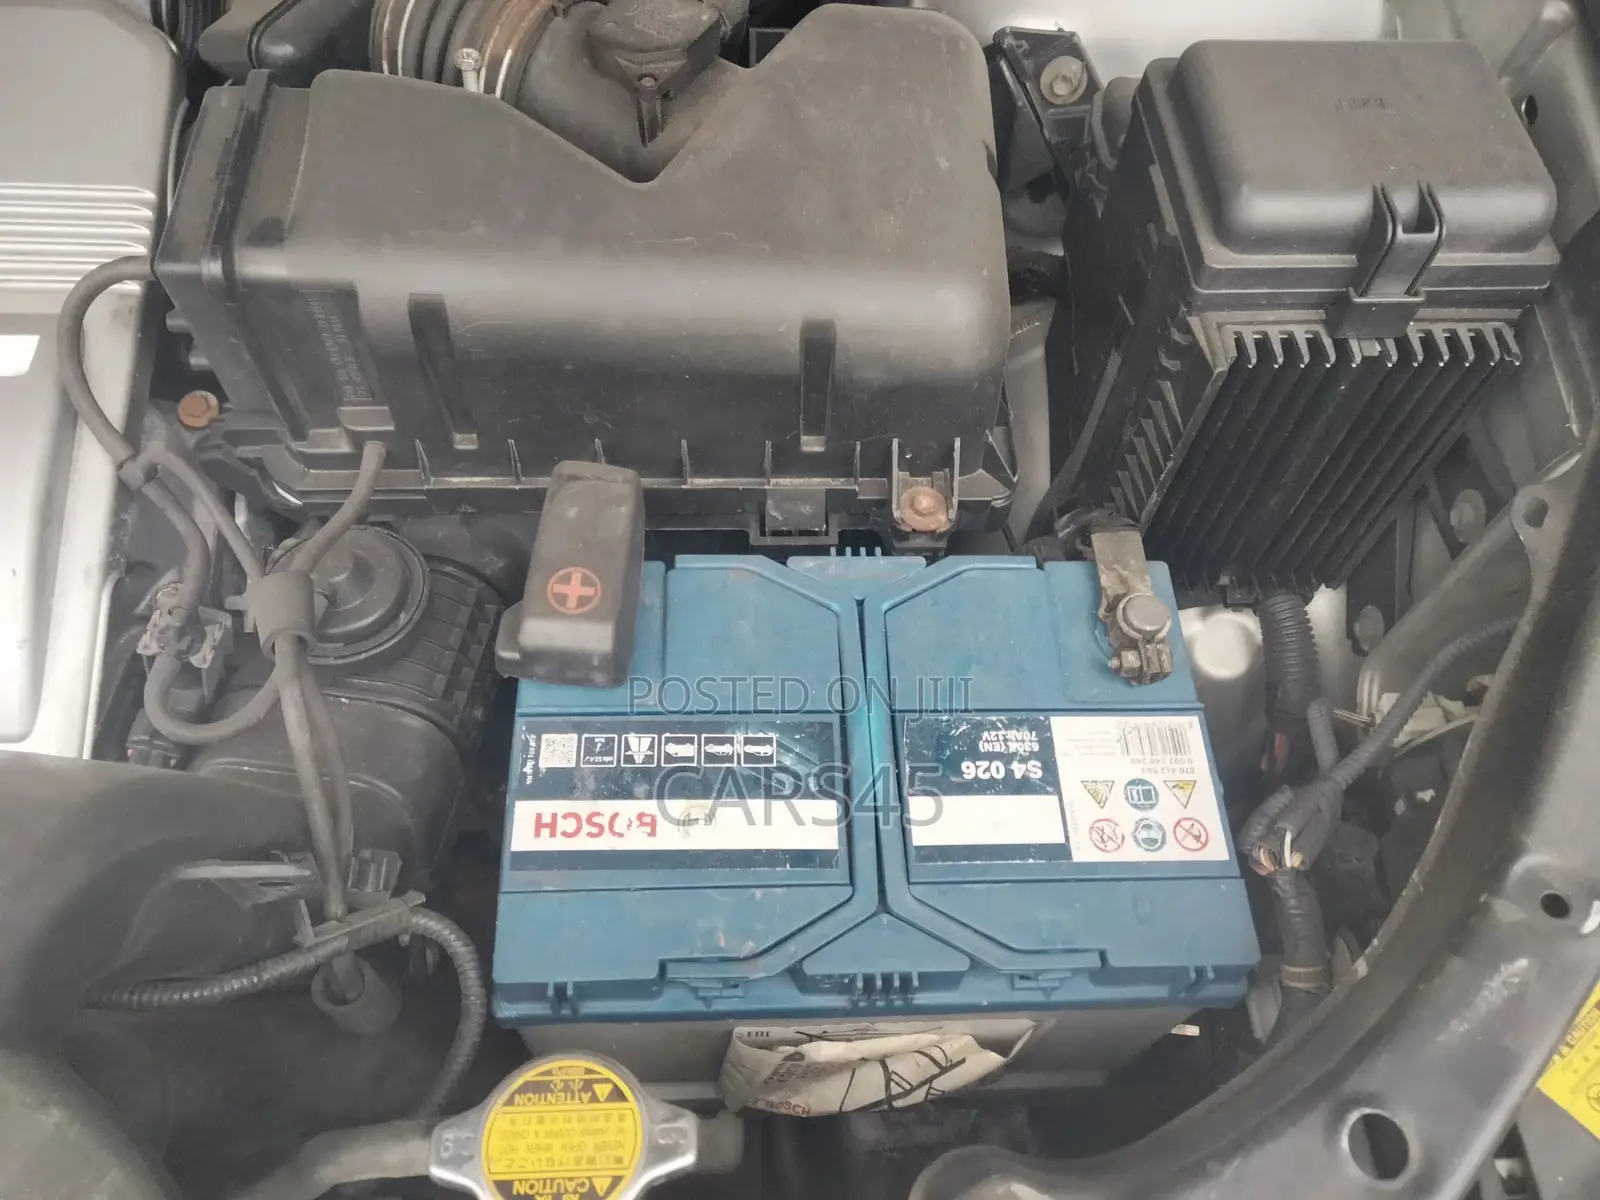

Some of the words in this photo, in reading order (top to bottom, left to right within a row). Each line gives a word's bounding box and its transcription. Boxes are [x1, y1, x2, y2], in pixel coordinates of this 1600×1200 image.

[979, 740, 1007, 753] (EN)
[961, 760, 1006, 780] 026
[1011, 760, 1043, 779] S4
[514, 1091, 592, 1106] ATTENTION
[512, 1178, 590, 1196] CAUTION
